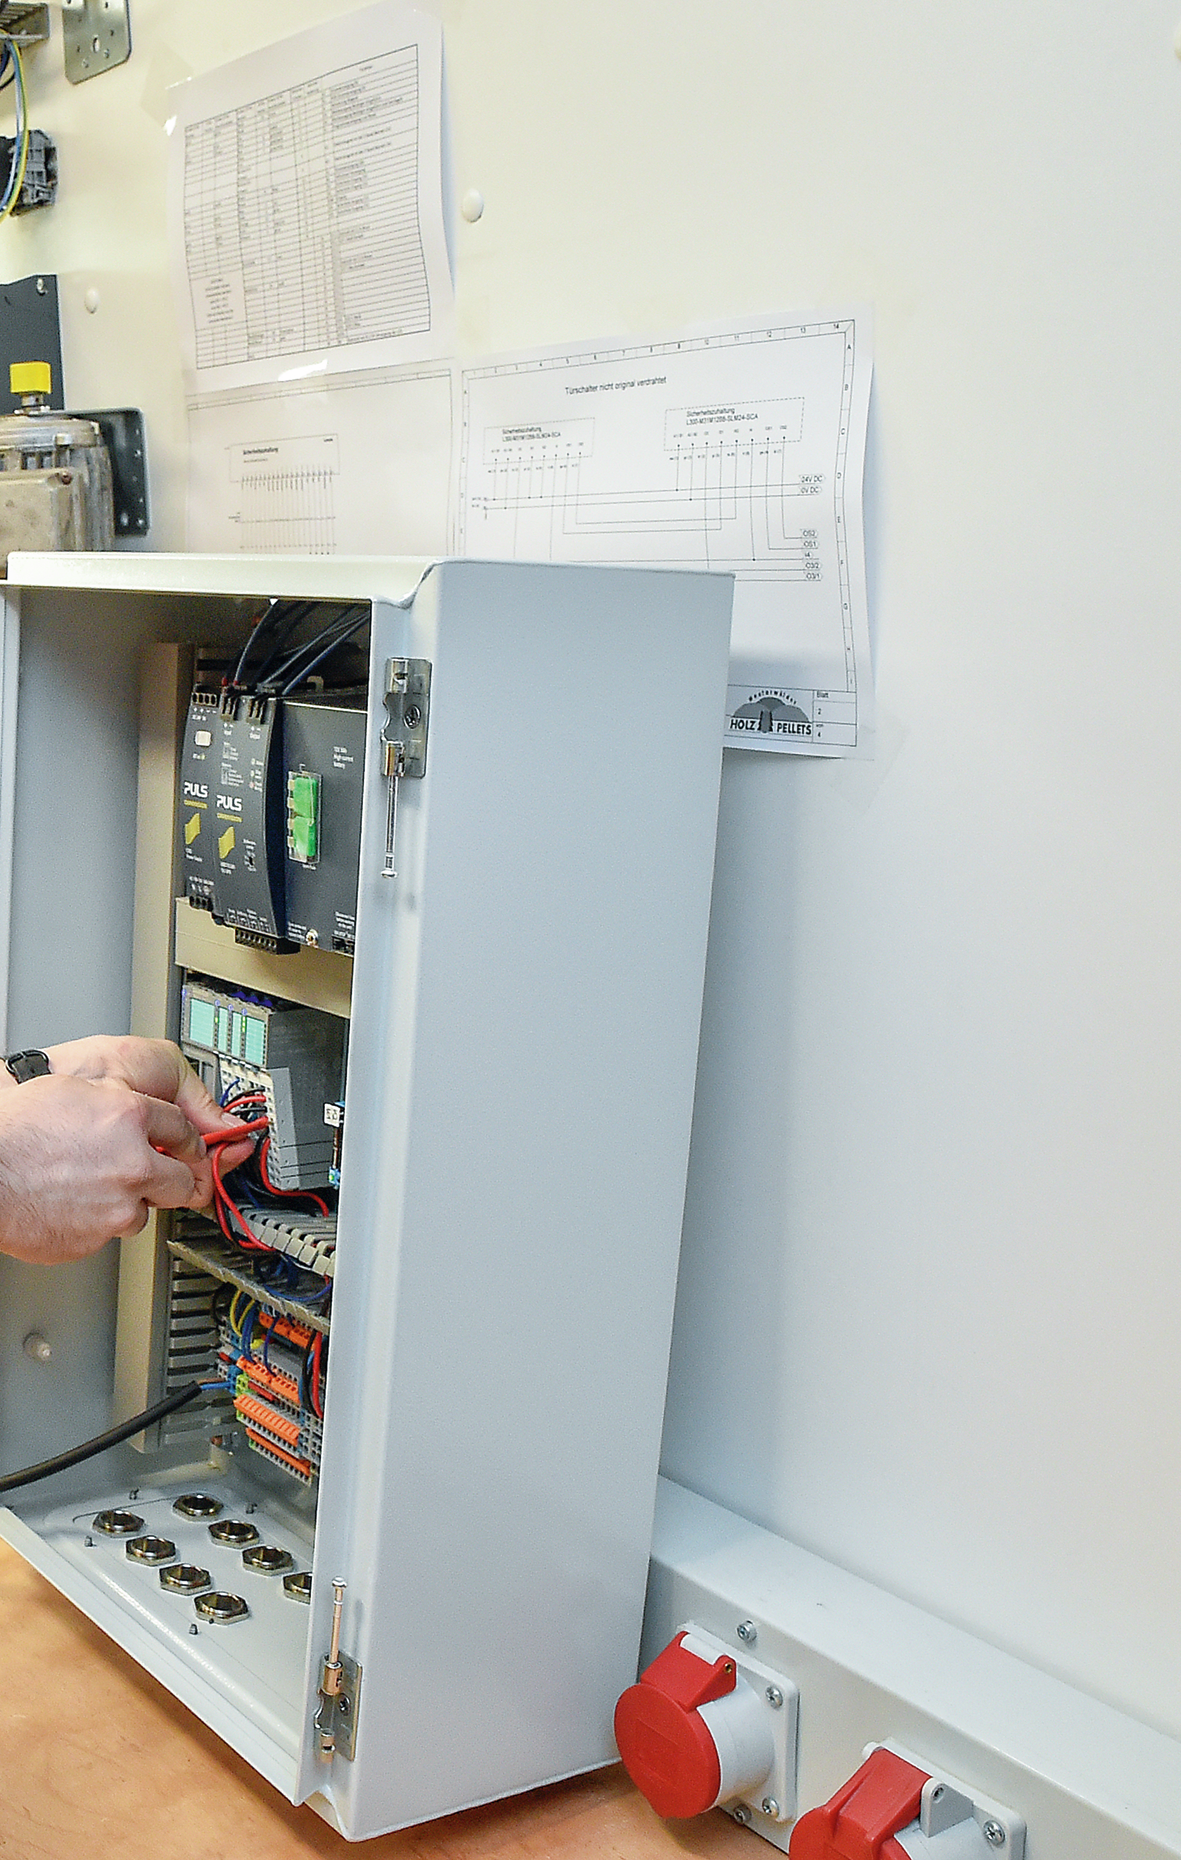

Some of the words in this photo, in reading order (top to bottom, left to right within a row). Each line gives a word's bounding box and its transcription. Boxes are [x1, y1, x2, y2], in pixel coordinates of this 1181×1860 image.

[730, 719, 756, 731] HOLZ
[776, 722, 812, 736] PELLETS
[183, 781, 209, 799] PULS
[216, 794, 243, 812] PULS
